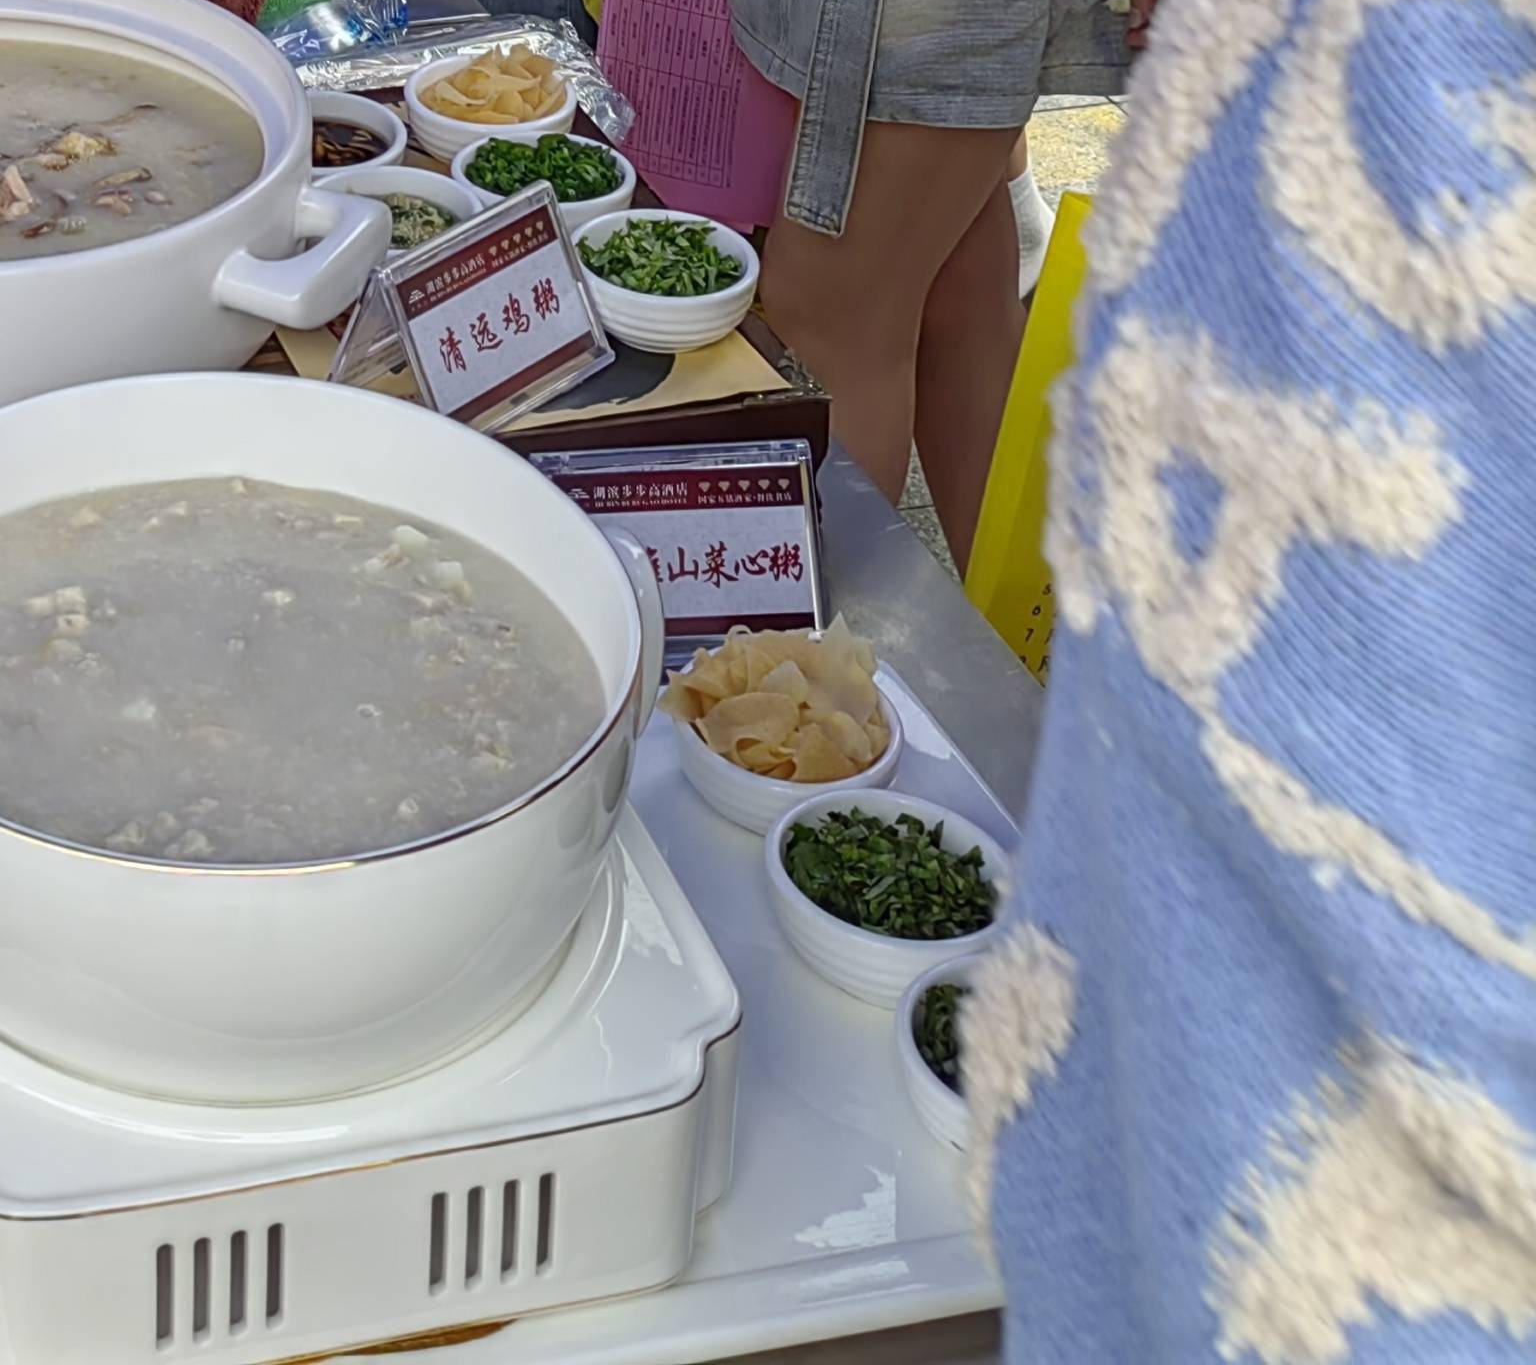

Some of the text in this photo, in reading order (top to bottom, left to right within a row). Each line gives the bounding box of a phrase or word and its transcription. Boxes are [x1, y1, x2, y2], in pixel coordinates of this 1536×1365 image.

[439, 277, 560, 373] 清远鸡粥
[593, 482, 688, 499] 湖滨步步高酒店
